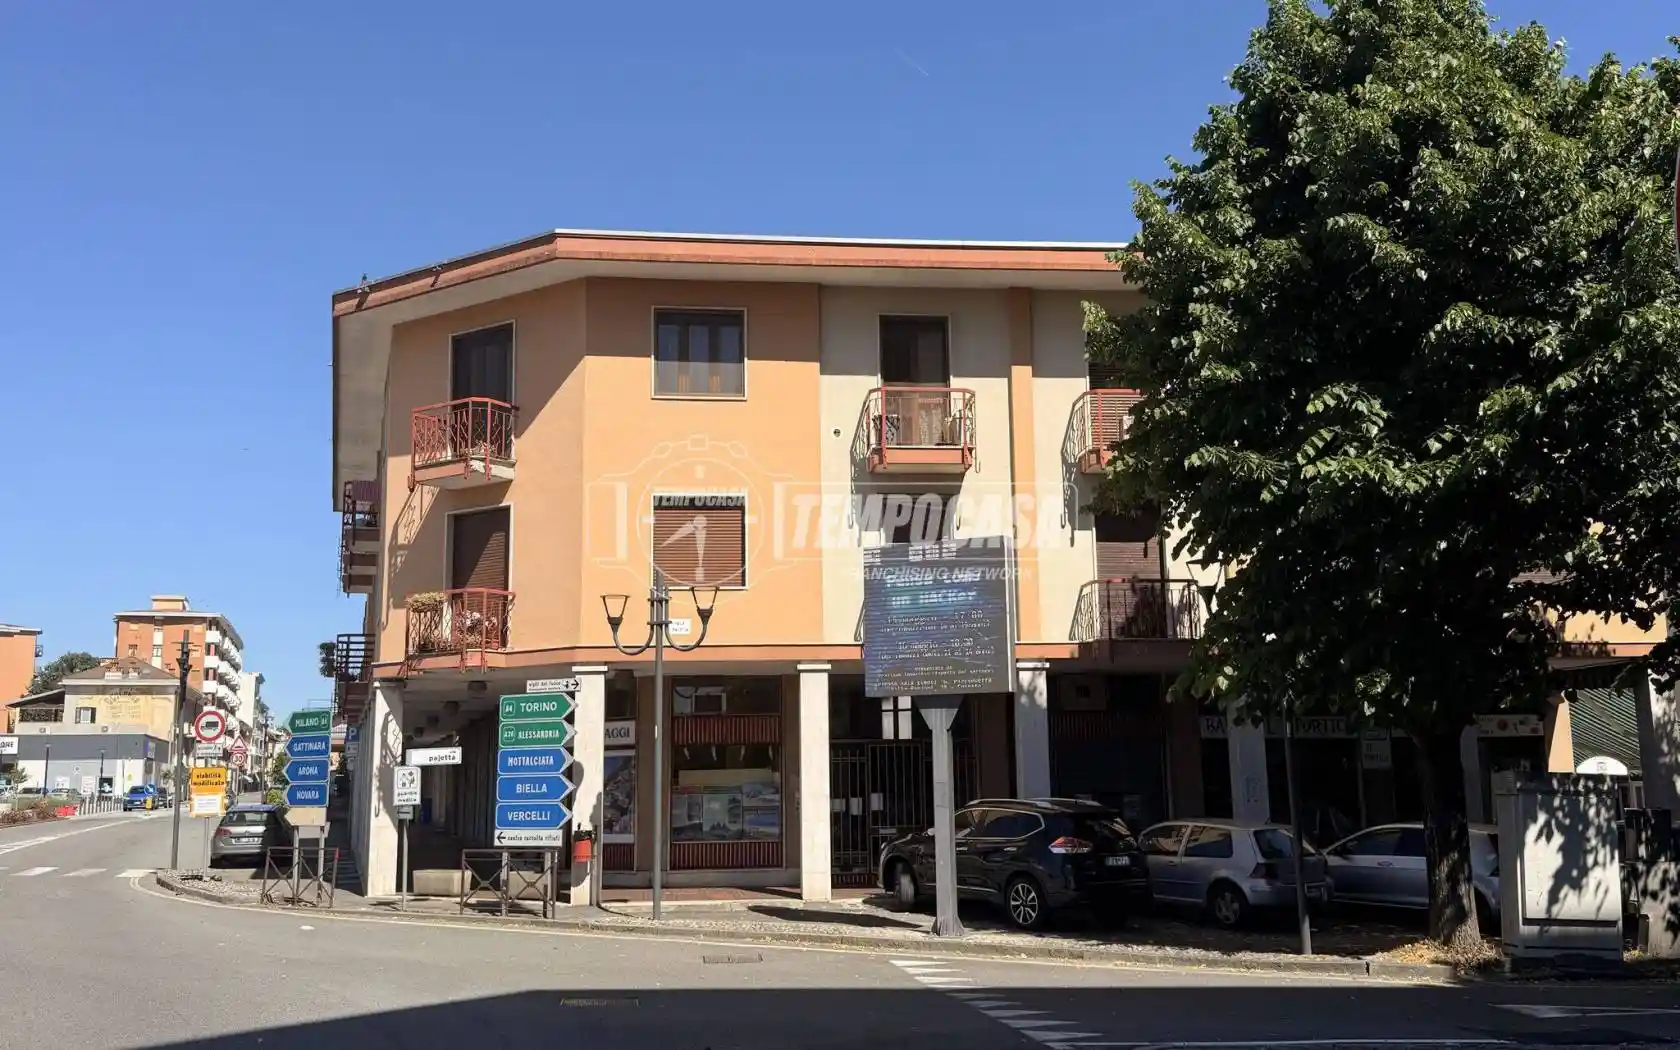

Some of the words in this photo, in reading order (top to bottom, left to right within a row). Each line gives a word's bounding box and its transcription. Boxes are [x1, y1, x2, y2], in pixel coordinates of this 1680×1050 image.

[519, 701, 558, 713] TORINO
[295, 718, 319, 728] MILANO
[518, 730, 560, 739] ALESSANDRIA
[604, 726, 630, 739] AGGI
[293, 742, 326, 752] GATTINARA
[507, 755, 554, 767] MOTTALCIATA
[297, 766, 319, 776] ARONA
[516, 783, 548, 793] BIELLA
[296, 790, 320, 801] NOVARA
[507, 811, 550, 821] VERCELLI
